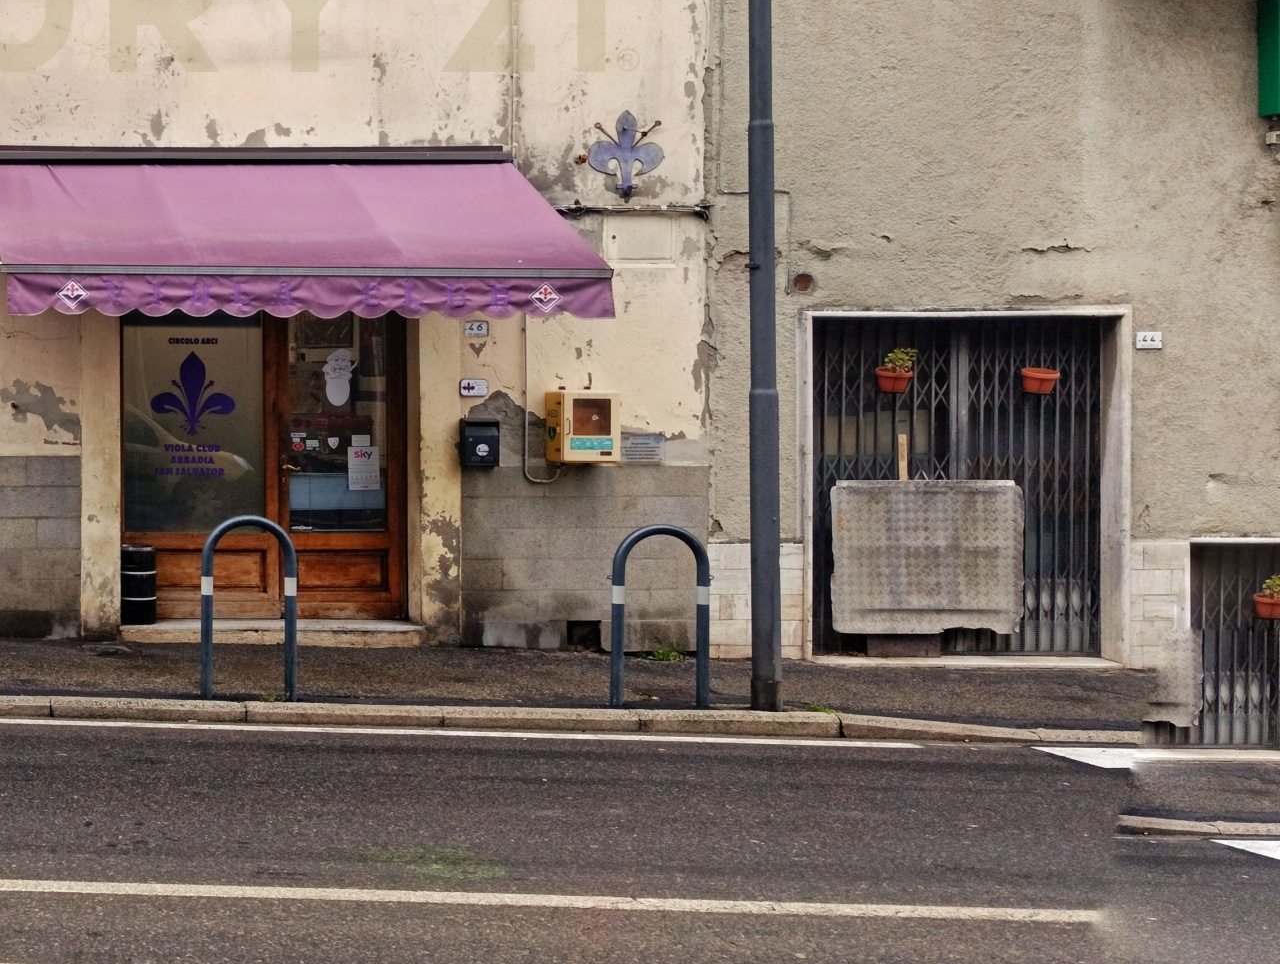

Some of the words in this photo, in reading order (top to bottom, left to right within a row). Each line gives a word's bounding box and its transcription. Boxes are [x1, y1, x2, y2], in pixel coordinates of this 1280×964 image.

[103, 279, 297, 307] VIOLA
[361, 281, 511, 309] CLUB
[468, 323, 483, 331] 46
[168, 337, 200, 345] CIRCOLO
[200, 337, 218, 345] ARCI
[1141, 334, 1156, 342] 44
[164, 444, 193, 452] VIOLA
[196, 444, 221, 453] CLUB
[353, 449, 373, 460] sky
[170, 456, 215, 464] ABBADIA
[154, 467, 173, 476] SAN
